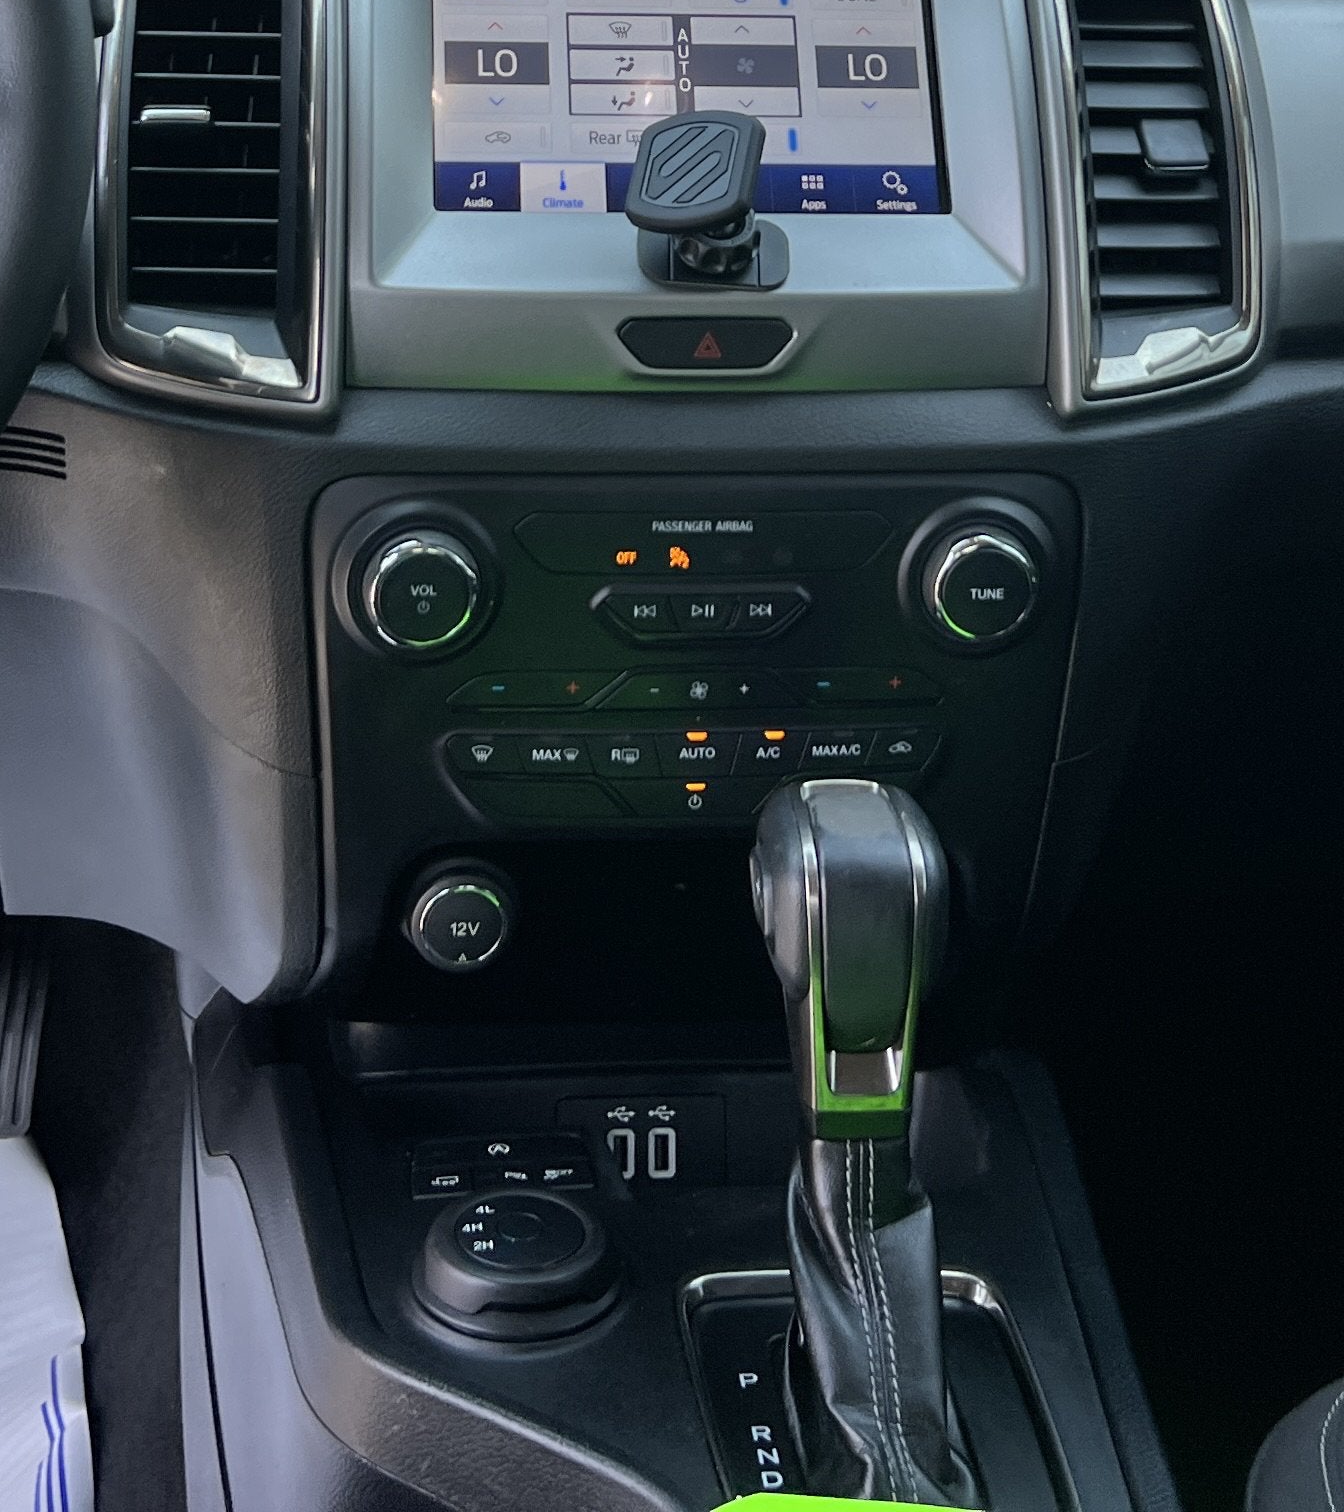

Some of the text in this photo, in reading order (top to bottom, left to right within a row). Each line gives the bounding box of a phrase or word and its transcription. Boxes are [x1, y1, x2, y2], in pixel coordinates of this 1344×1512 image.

[477, 48, 518, 78] LO
[847, 52, 888, 82] LO
[588, 130, 622, 146] Rear
[463, 197, 494, 209] Audio
[542, 197, 584, 210] Climate
[801, 199, 827, 212] Apps
[876, 199, 917, 212] Settings
[651, 520, 754, 533] PASSENGER AIRBAG
[615, 550, 637, 565] OFF
[410, 584, 437, 597] VOL
[969, 588, 1005, 601] TUNE
[531, 748, 562, 761] MAX
[679, 747, 716, 760] AUTO
[756, 746, 781, 759] A/C
[811, 744, 862, 757] MAX A/C
[449, 921, 481, 937] 12V
[475, 1205, 496, 1215] 4L
[461, 1221, 484, 1233] 4H
[473, 1239, 494, 1252] 2H
[738, 1372, 759, 1388] P
[751, 1425, 772, 1442] R
[756, 1448, 781, 1466] N
[761, 1470, 784, 1489] D
